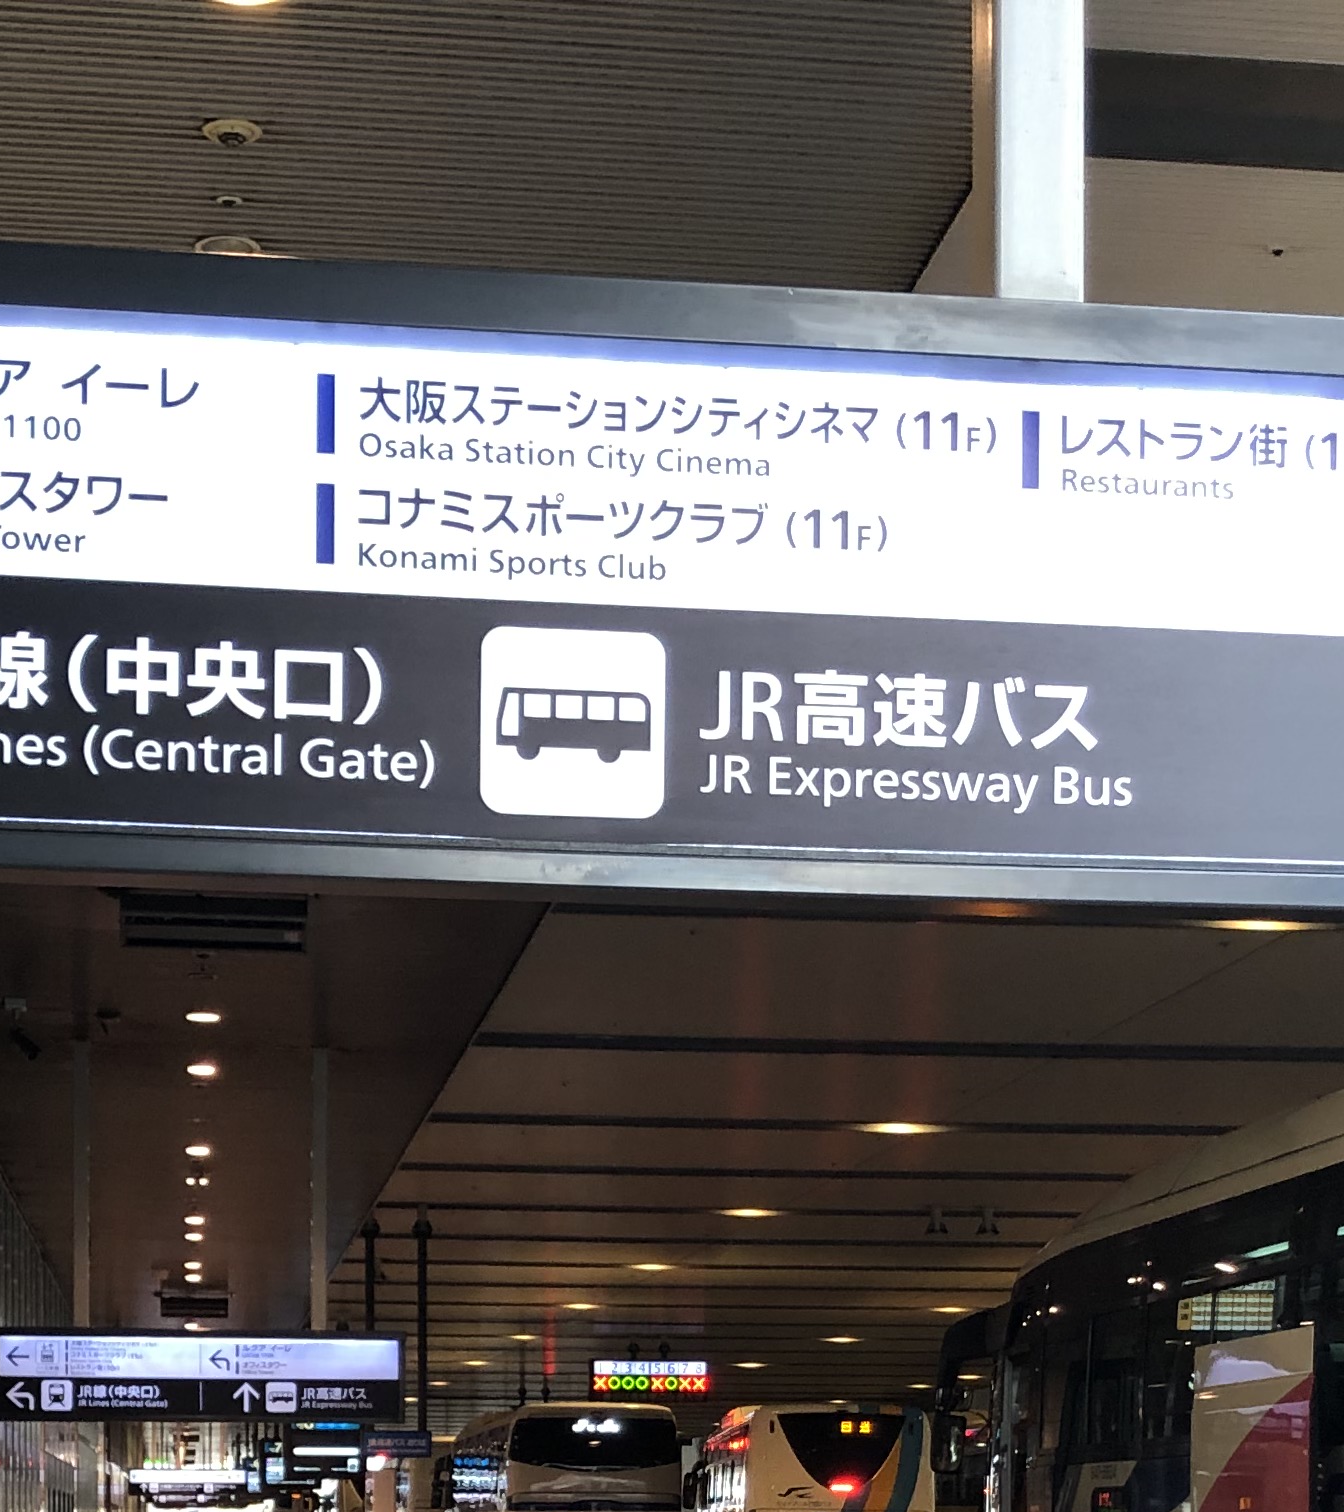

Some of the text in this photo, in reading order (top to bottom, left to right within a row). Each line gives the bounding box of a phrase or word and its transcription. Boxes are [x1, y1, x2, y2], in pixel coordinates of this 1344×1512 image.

[61, 361, 201, 410] イーレ
[358, 376, 880, 444] 大阪ステーションシティシネマ
[5, 413, 83, 443] 1100
[358, 431, 772, 478] Osaka Station City Cinema
[1060, 416, 1289, 470] レストラン街
[1060, 468, 1236, 501] Restaurants
[356, 485, 770, 546] コナミスポーツクラブ
[357, 542, 667, 585] Konami Sports Club
[698, 666, 1100, 753] JR高速バス
[82, 722, 284, 778] (Central
[299, 736, 438, 790] Gate)
[698, 754, 1134, 816] JR Expressway Bus
